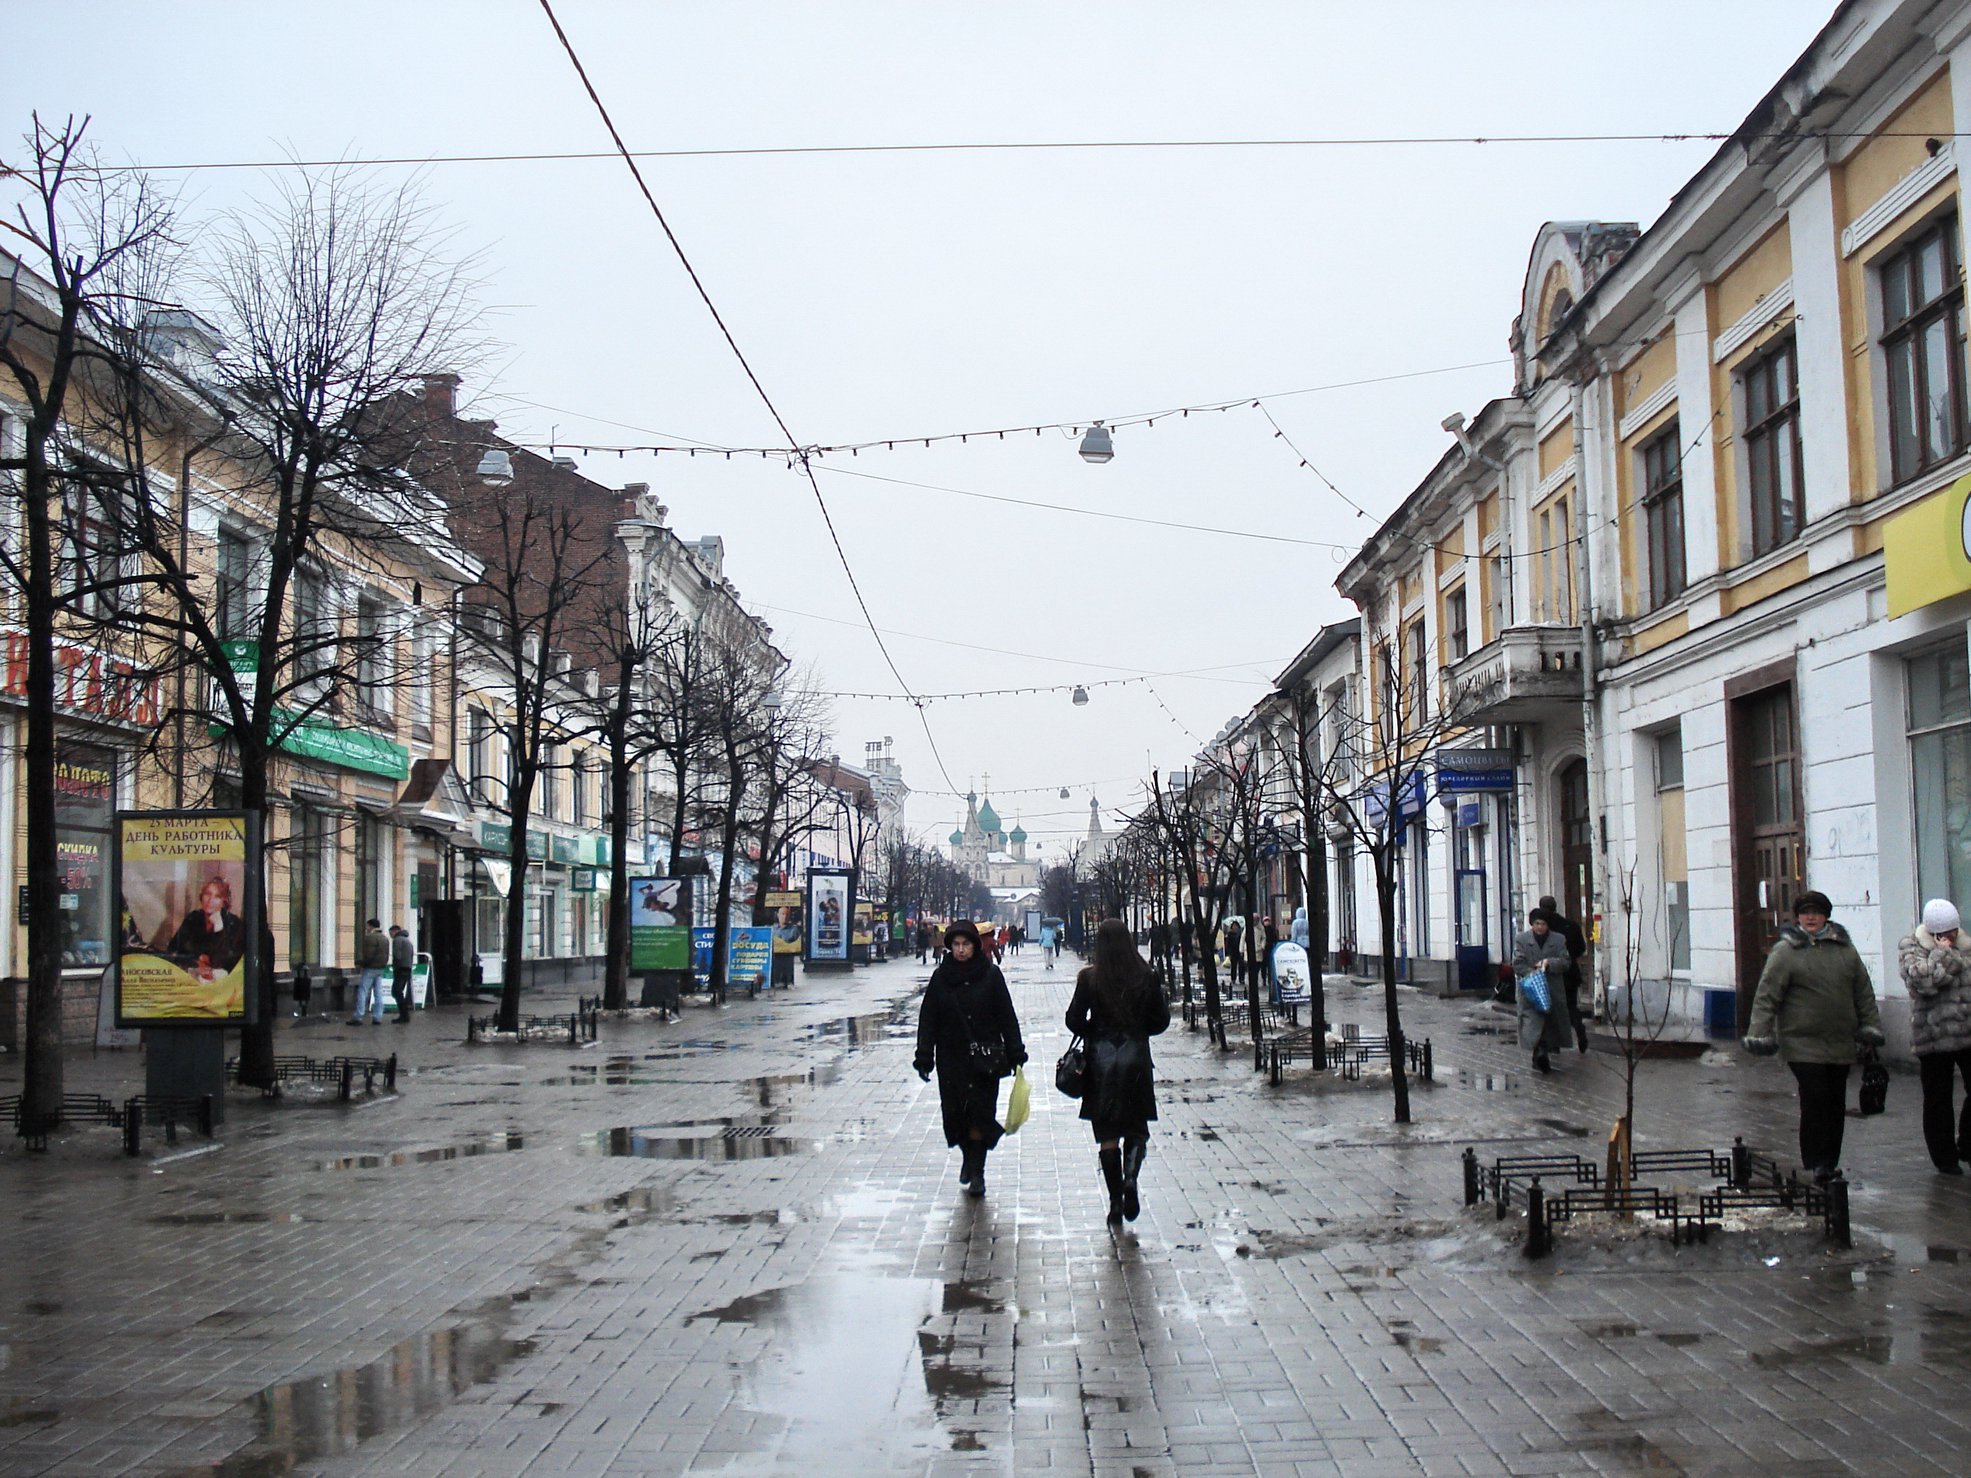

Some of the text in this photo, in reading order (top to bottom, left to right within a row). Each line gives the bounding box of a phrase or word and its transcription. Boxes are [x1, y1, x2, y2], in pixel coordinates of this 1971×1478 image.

[164, 819, 208, 827] МАРТА
[126, 831, 242, 843] ДЕНЬ РАБОТНИКА
[151, 845, 220, 855] КУЛЬТУРЫ
